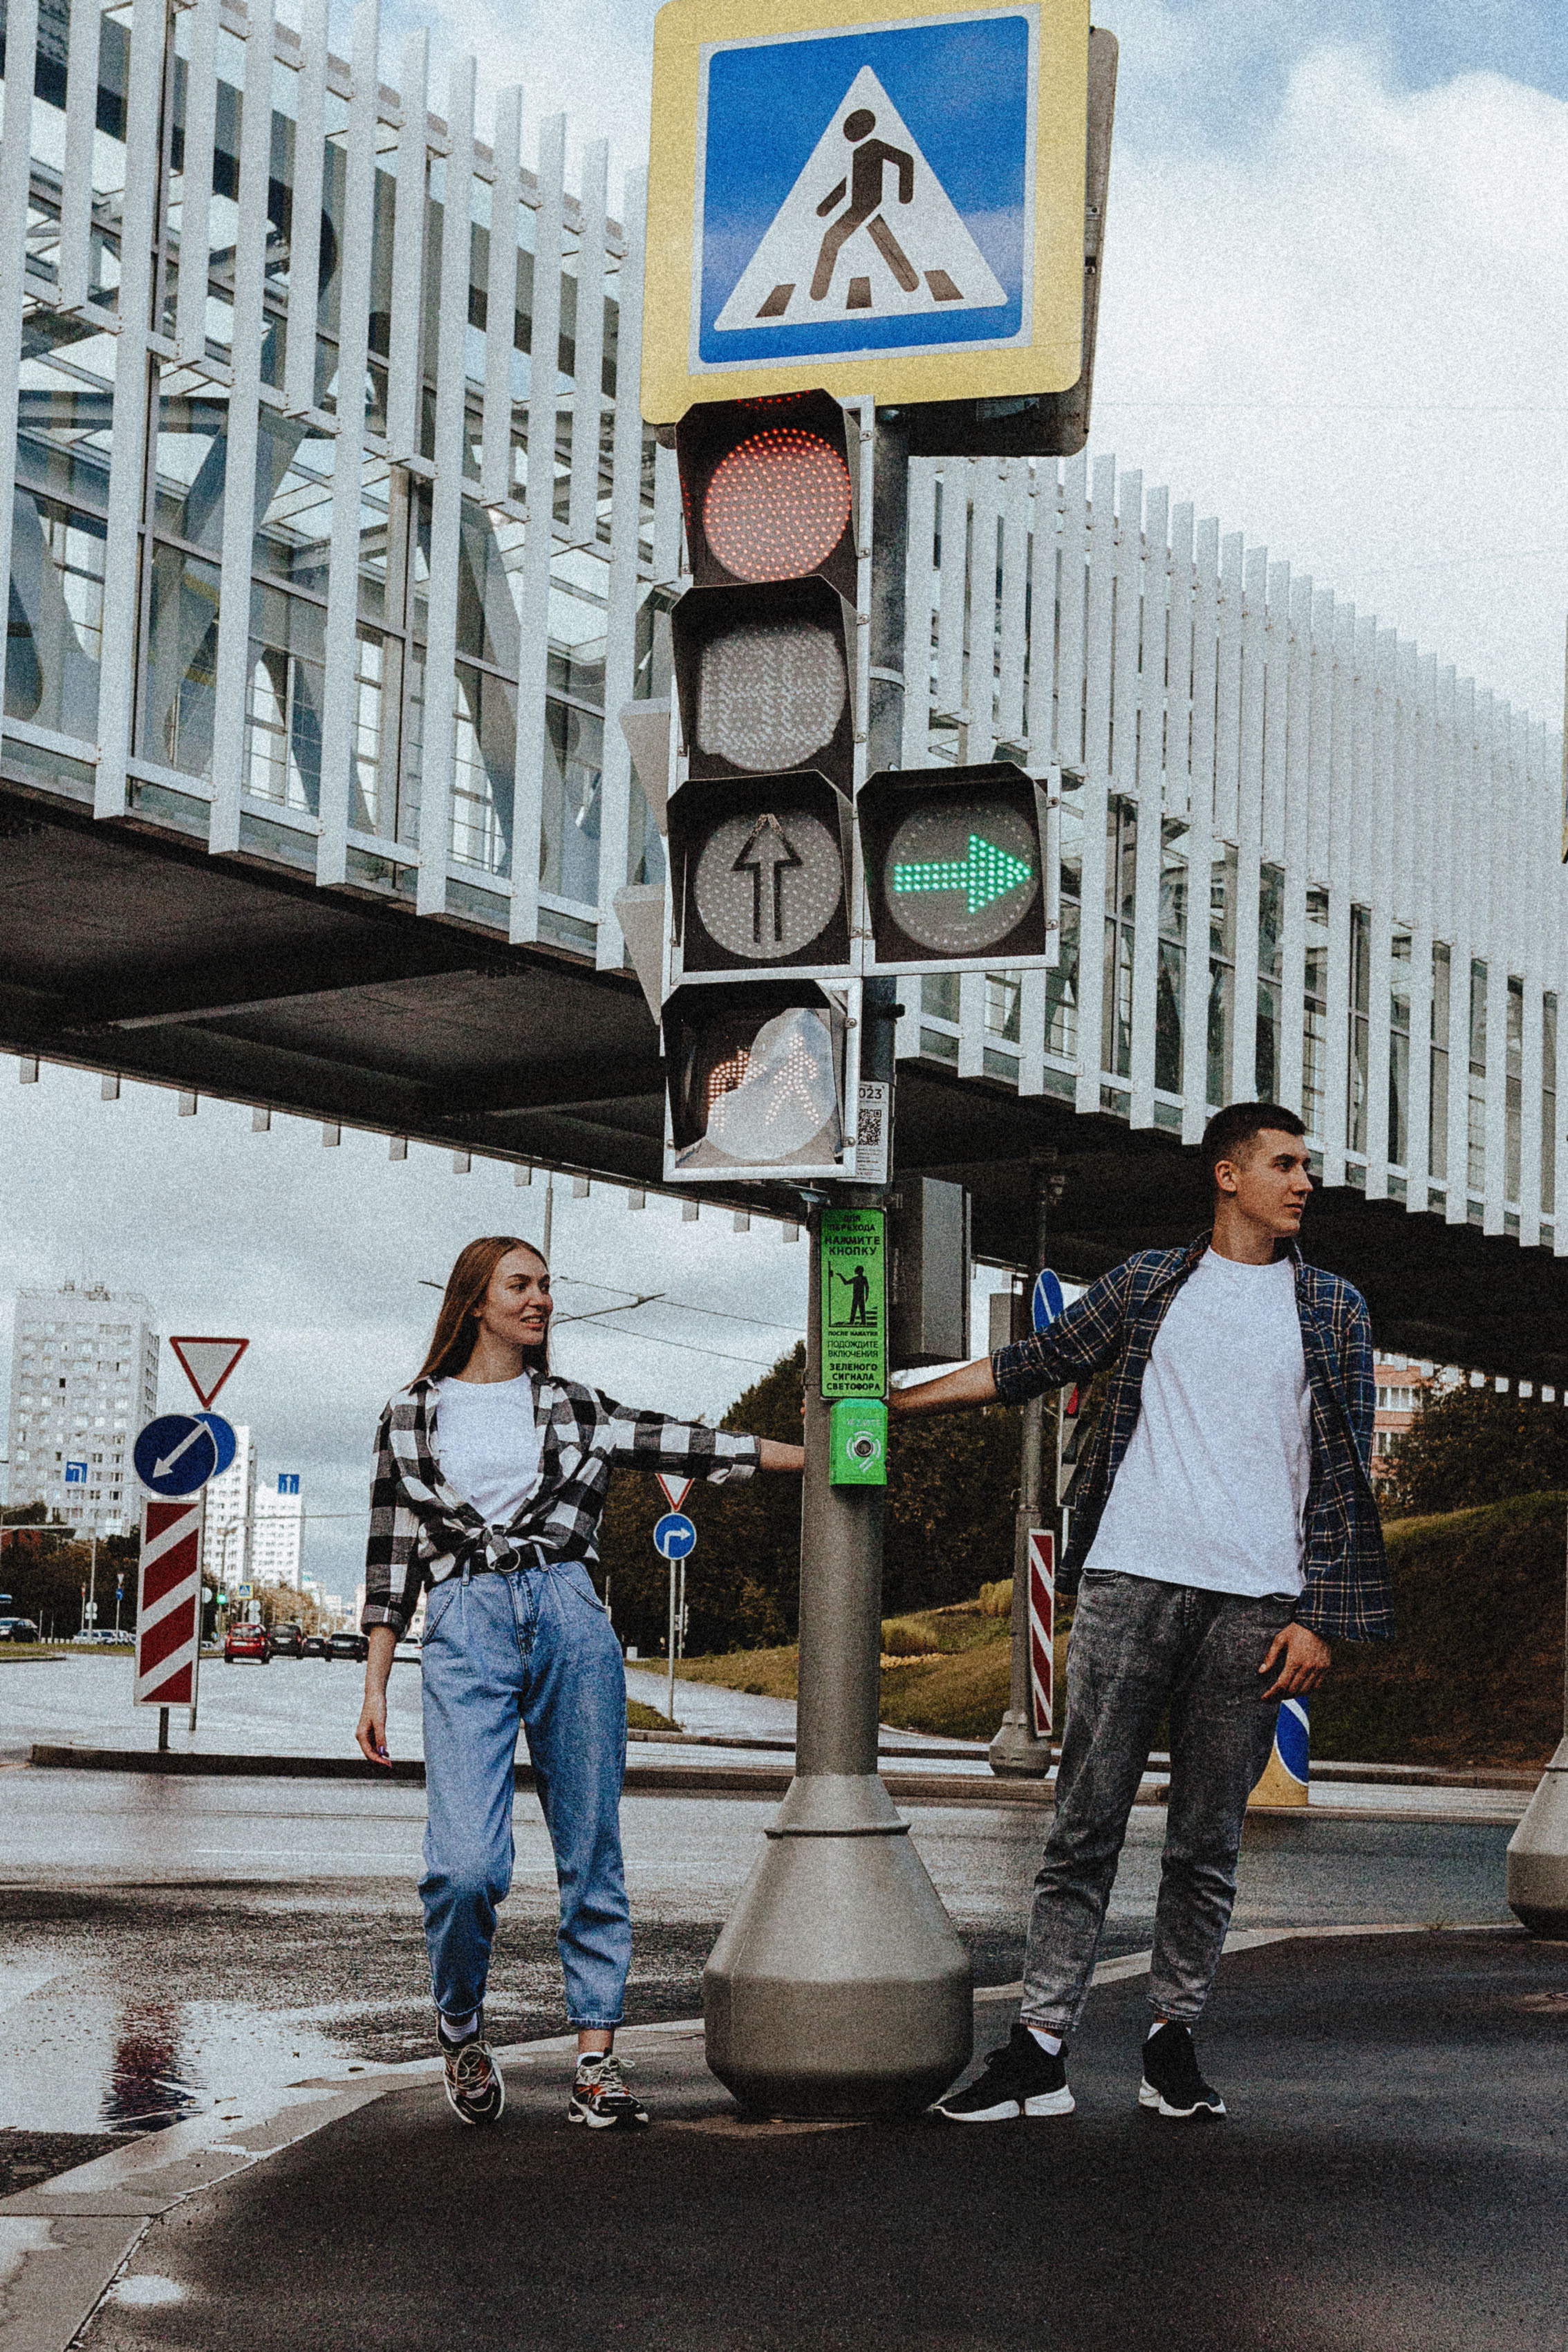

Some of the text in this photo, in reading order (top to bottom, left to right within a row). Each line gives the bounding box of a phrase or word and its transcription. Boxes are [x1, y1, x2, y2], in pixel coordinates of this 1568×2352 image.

[859, 1088, 882, 1099] 023
[829, 1224, 876, 1232] ПЕРЕХОДА
[825, 1235, 880, 1245] НАЖМИТЕ
[829, 1246, 877, 1256] КНОПКУ
[828, 1341, 878, 1349] ПОДОЖДИТЕ
[828, 1350, 878, 1358] ВКЛЮЧЕНИЯ
[829, 1363, 878, 1371] ЗЕЛЕНОГО
[832, 1372, 875, 1381] СИГНАЛА
[826, 1382, 881, 1391] СВЕТОФОРА
